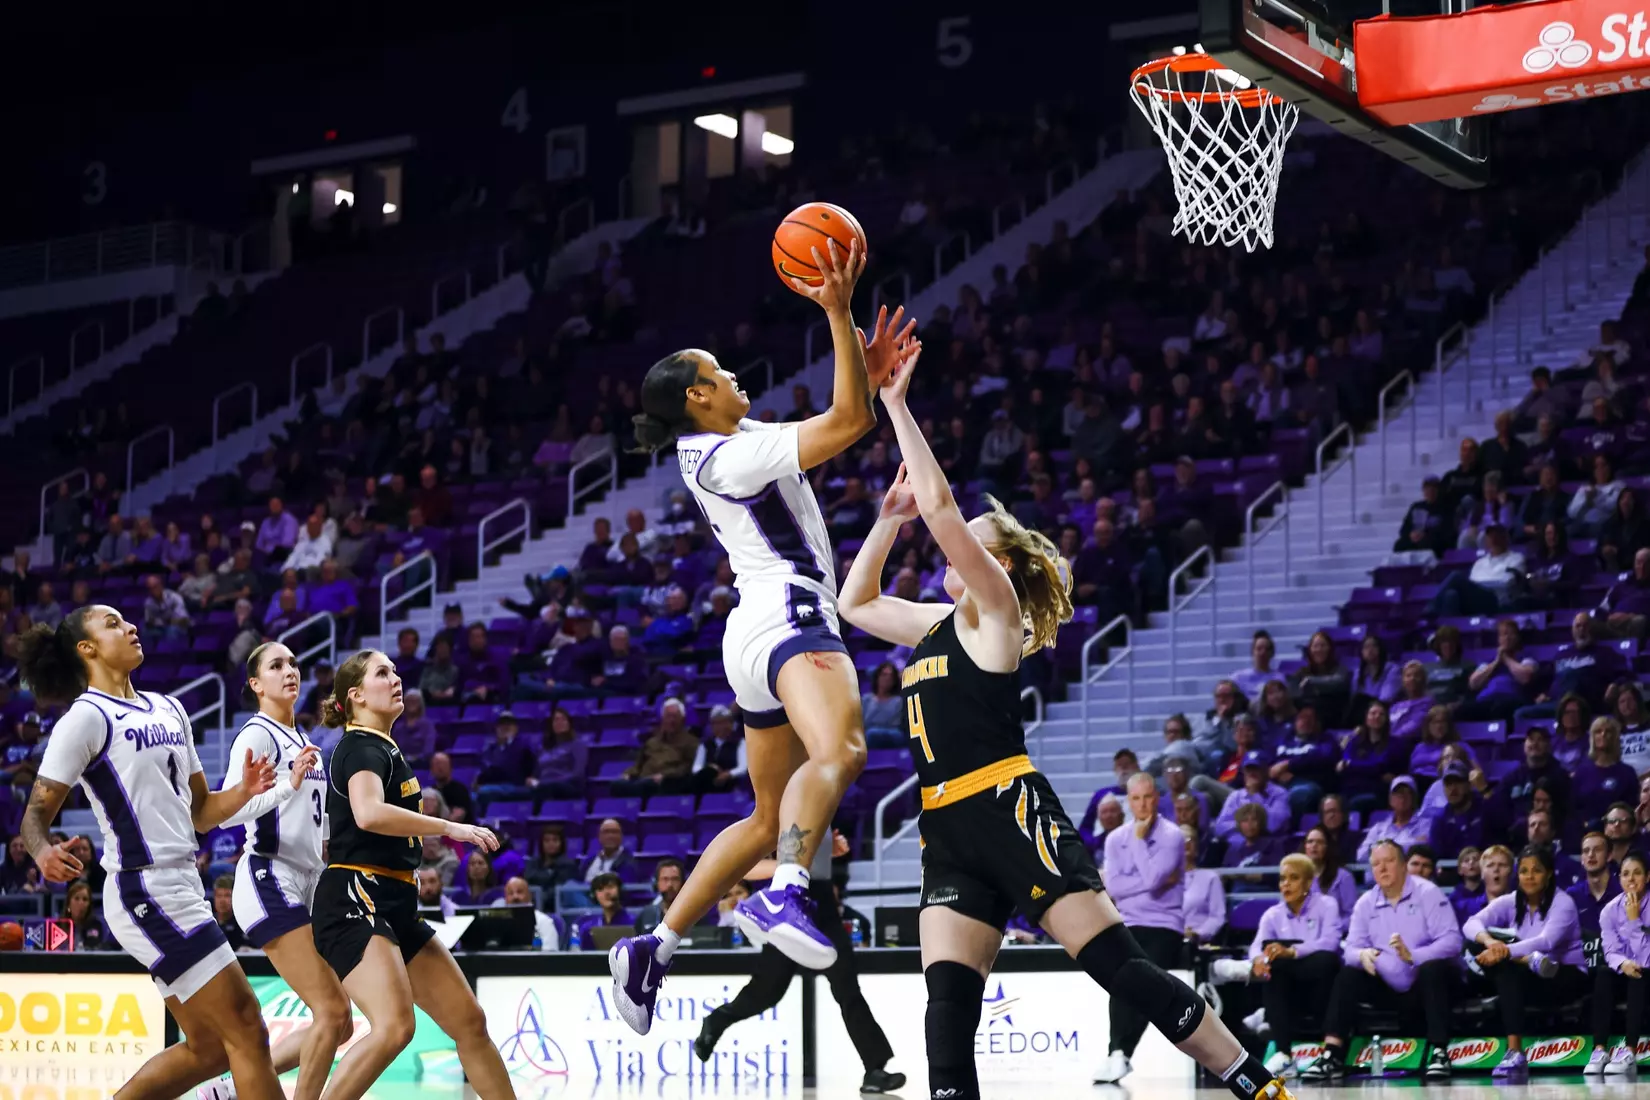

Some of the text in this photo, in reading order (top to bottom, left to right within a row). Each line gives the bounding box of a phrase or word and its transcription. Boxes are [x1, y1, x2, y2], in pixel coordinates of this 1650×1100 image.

[937, 17, 973, 68] 5
[1598, 11, 1650, 62] St
[501, 86, 532, 133] 4
[83, 161, 107, 204] 3
[907, 692, 935, 763] 4
[167, 752, 180, 796] 1
[311, 788, 322, 828] 3
[89, 1041, 144, 1055] EATS
[586, 1039, 645, 1076] Via
[1290, 1047, 1327, 1058] MAN
[1355, 1041, 1412, 1064] LIMAN
